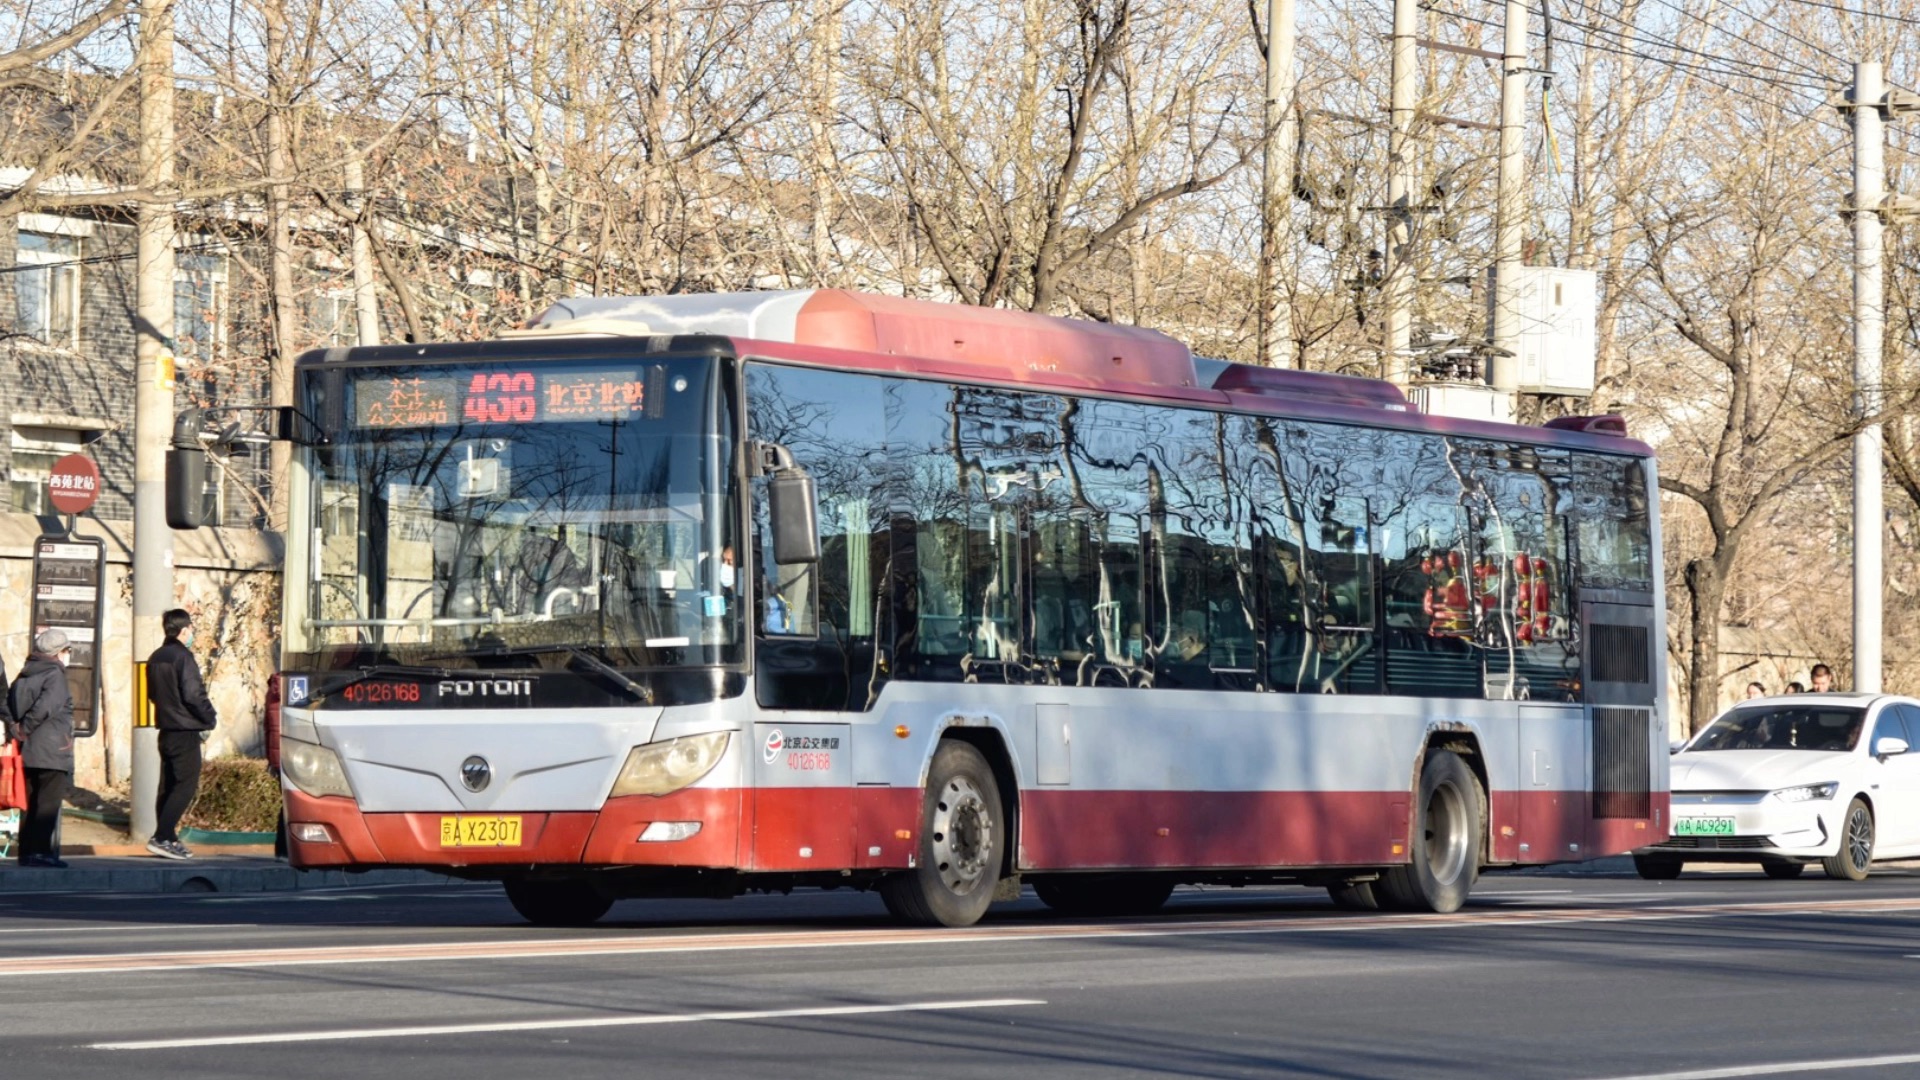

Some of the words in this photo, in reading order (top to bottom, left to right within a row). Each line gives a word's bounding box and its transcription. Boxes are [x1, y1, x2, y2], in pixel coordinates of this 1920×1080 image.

[465, 372, 536, 422] 438
[49, 474, 95, 491] 西苑北站
[343, 681, 420, 701] 40126168
[783, 737, 840, 750] 北京公交集团
[787, 752, 831, 770] 40126168
